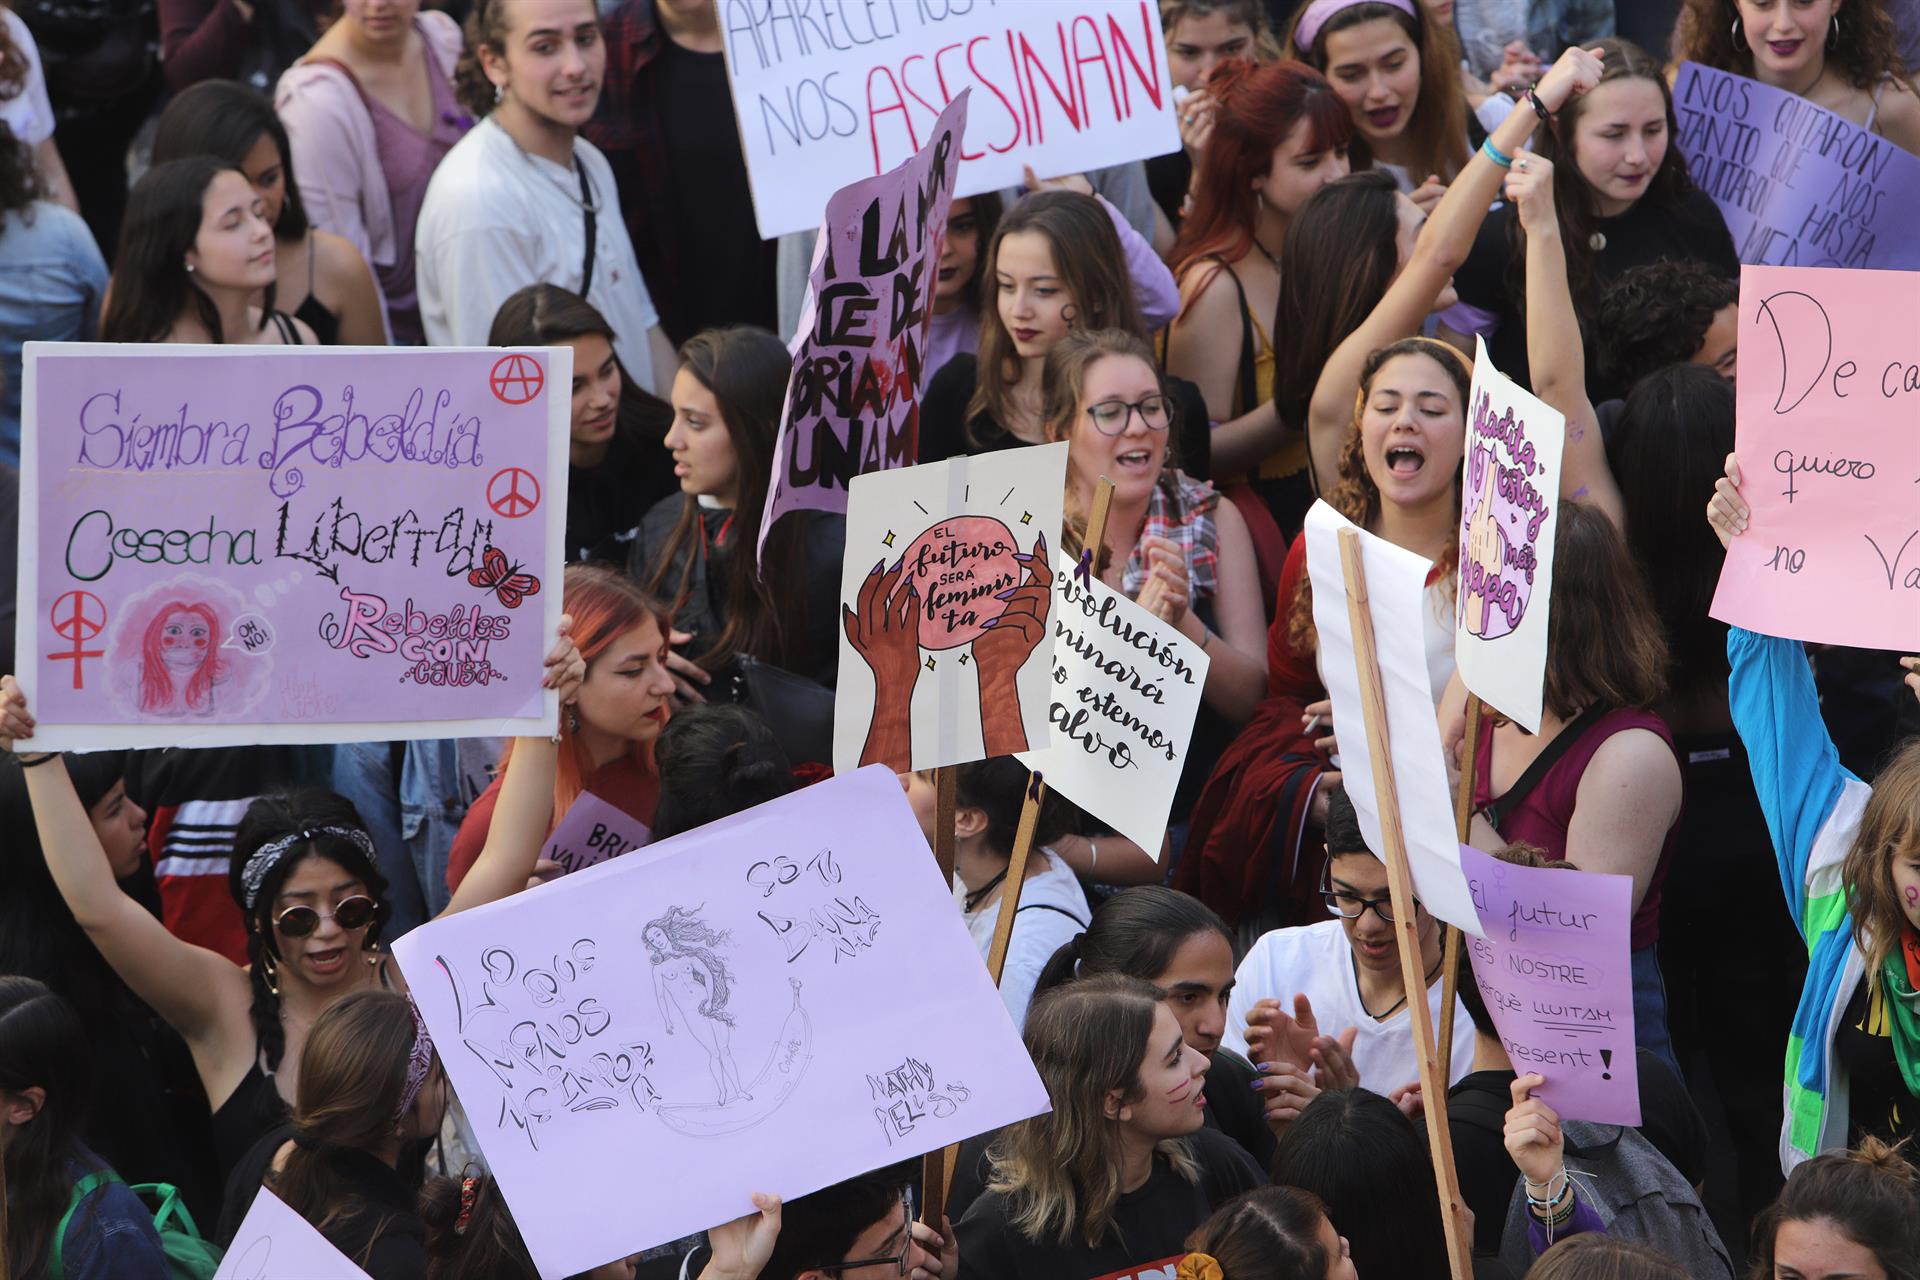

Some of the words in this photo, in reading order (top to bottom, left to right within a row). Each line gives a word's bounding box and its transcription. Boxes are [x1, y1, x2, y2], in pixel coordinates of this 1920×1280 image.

[759, 72, 858, 156] NOS
[1684, 69, 1752, 121] NOS
[1774, 97, 1894, 184] QUITARON
[1678, 107, 1761, 166] TANTO
[1827, 172, 1886, 226] NOS
[1757, 291, 1857, 414] De
[78, 388, 249, 472] Siembra
[1497, 463, 1549, 543] estoy
[1774, 450, 1876, 504] quiero
[66, 509, 263, 582] Cosecha
[908, 540, 1012, 578] futuro
[934, 527, 955, 539] EL
[1764, 545, 1806, 574] no
[922, 573, 1016, 621] feminis
[940, 564, 976, 586] SERÁ
[238, 620, 258, 638] OH
[243, 632, 271, 652] NO!
[319, 586, 511, 659] Rebeldes
[941, 609, 980, 633] ta
[1076, 686, 1177, 761] estemos
[1469, 880, 1488, 912] El
[1508, 900, 1598, 942] futur
[522, 938, 596, 1008] QUE
[1509, 953, 1588, 985] NOSTRE
[463, 998, 611, 1089] MENOS
